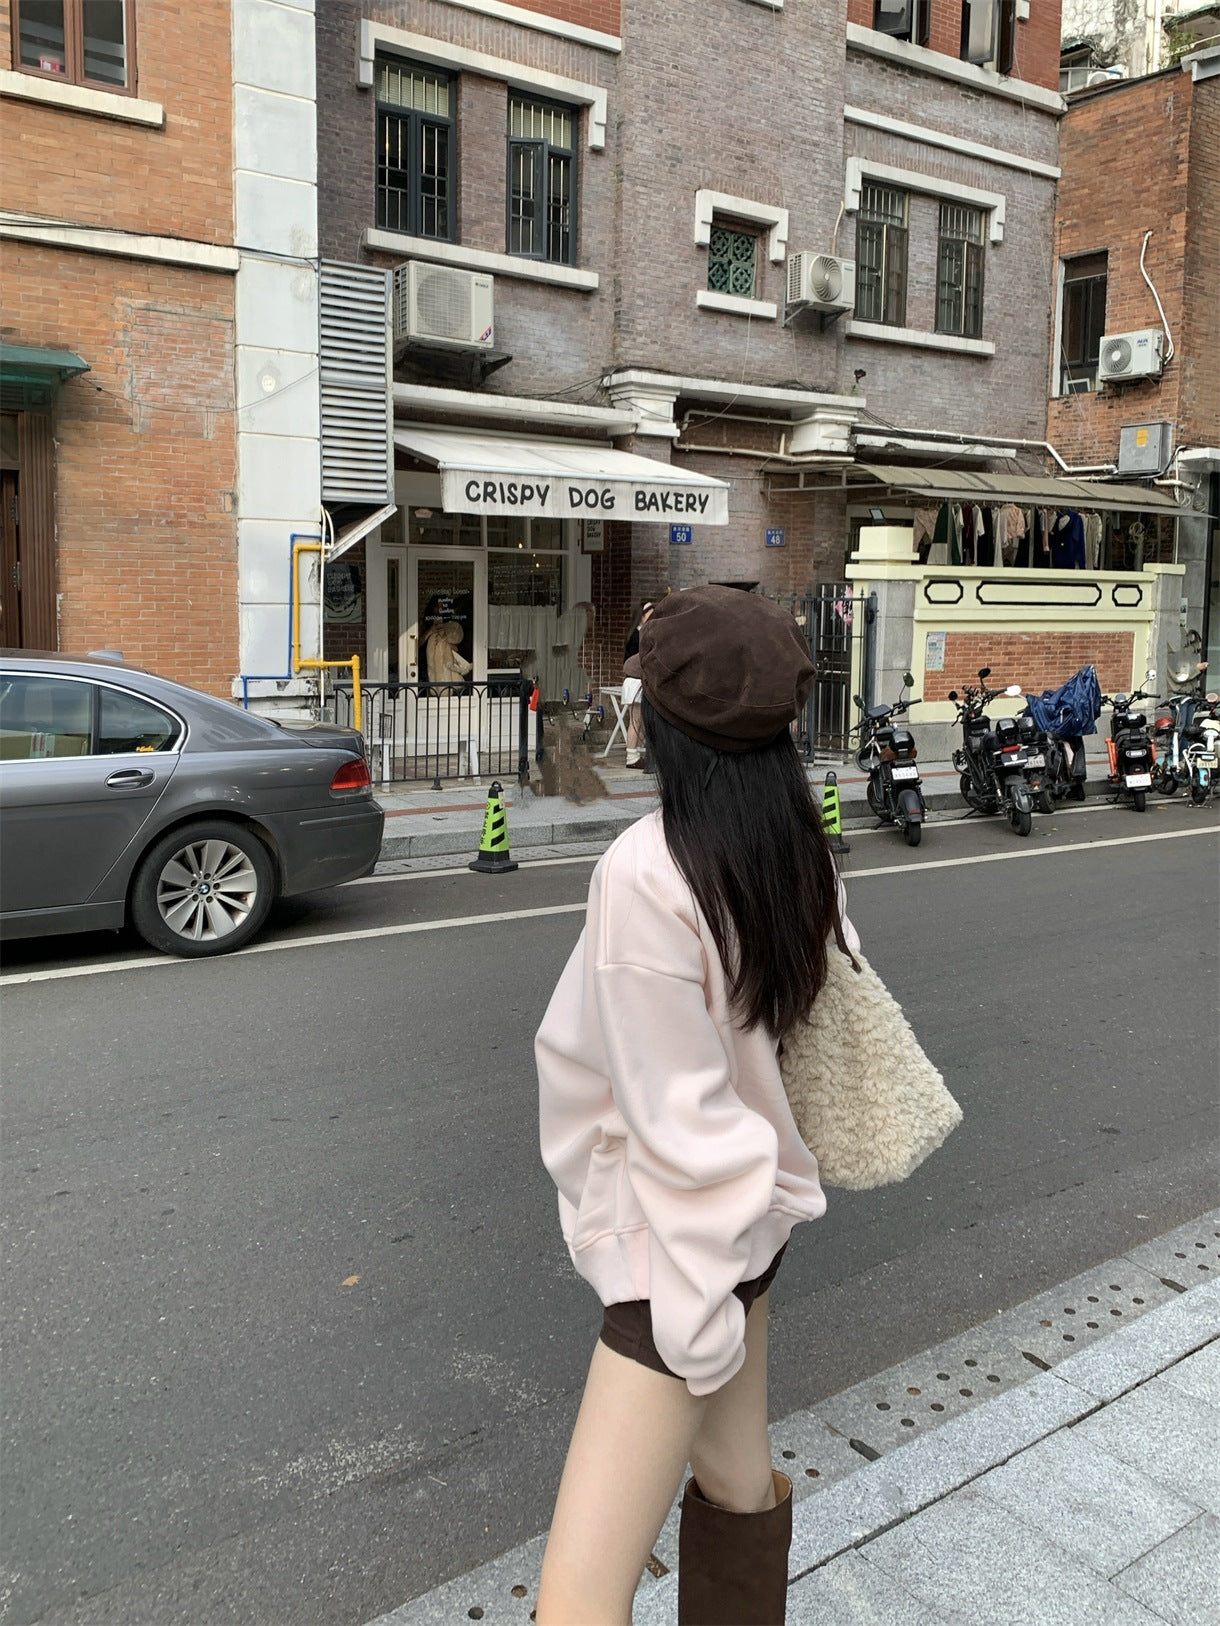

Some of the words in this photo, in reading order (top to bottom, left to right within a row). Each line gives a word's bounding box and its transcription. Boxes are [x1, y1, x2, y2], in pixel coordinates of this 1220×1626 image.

[465, 480, 550, 507] CRISPY
[568, 486, 616, 510] DOG
[634, 490, 710, 514] BAKERY
[676, 532, 687, 542] 50
[770, 535, 781, 545] 48
